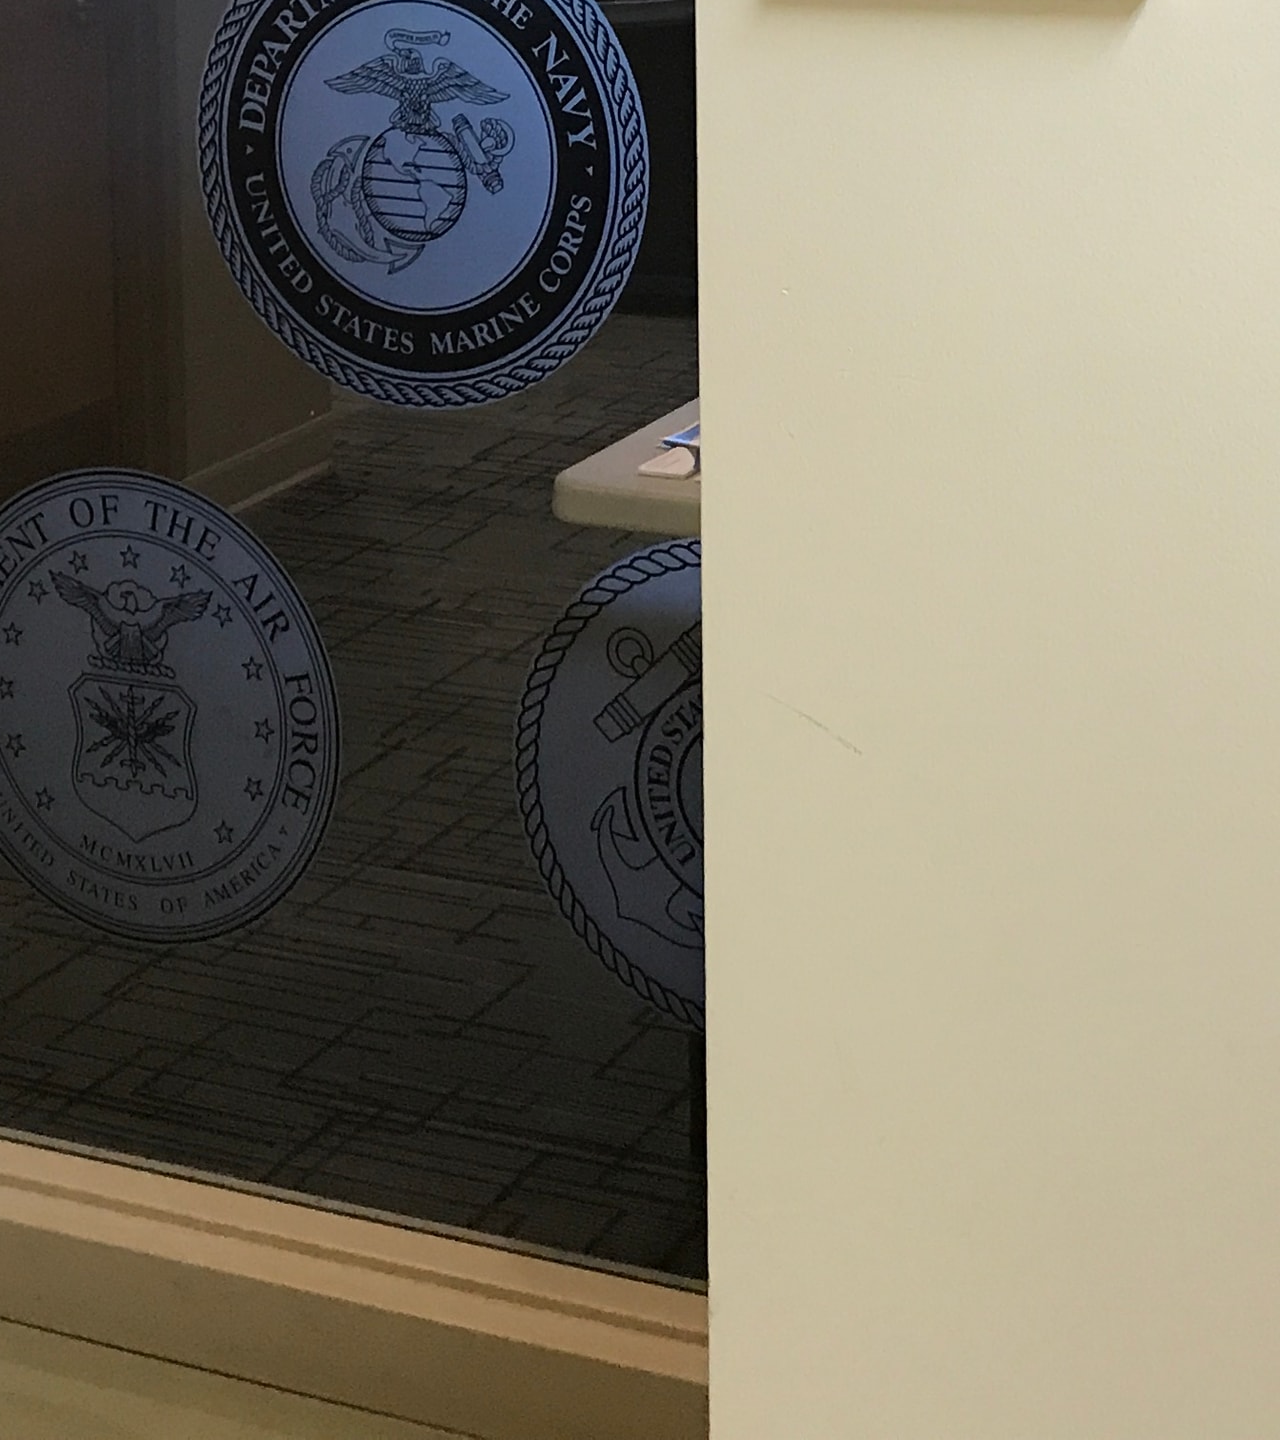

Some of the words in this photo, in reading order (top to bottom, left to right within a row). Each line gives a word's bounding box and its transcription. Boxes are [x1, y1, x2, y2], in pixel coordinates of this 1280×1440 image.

[531, 30, 598, 152] NAVY
[245, 171, 315, 296] UNITED
[315, 293, 415, 356] STATES
[430, 291, 542, 356] MARINE
[538, 192, 593, 294] CORPS
[68, 494, 120, 529] OF
[143, 498, 222, 563] THE
[231, 571, 291, 644] AIR
[281, 670, 320, 817] FORCE
[79, 834, 195, 873] MCMXLVII
[647, 744, 696, 866] UNITED
[66, 870, 138, 911] STATES
[160, 896, 188, 914] OF
[204, 844, 281, 908] AMERICA
